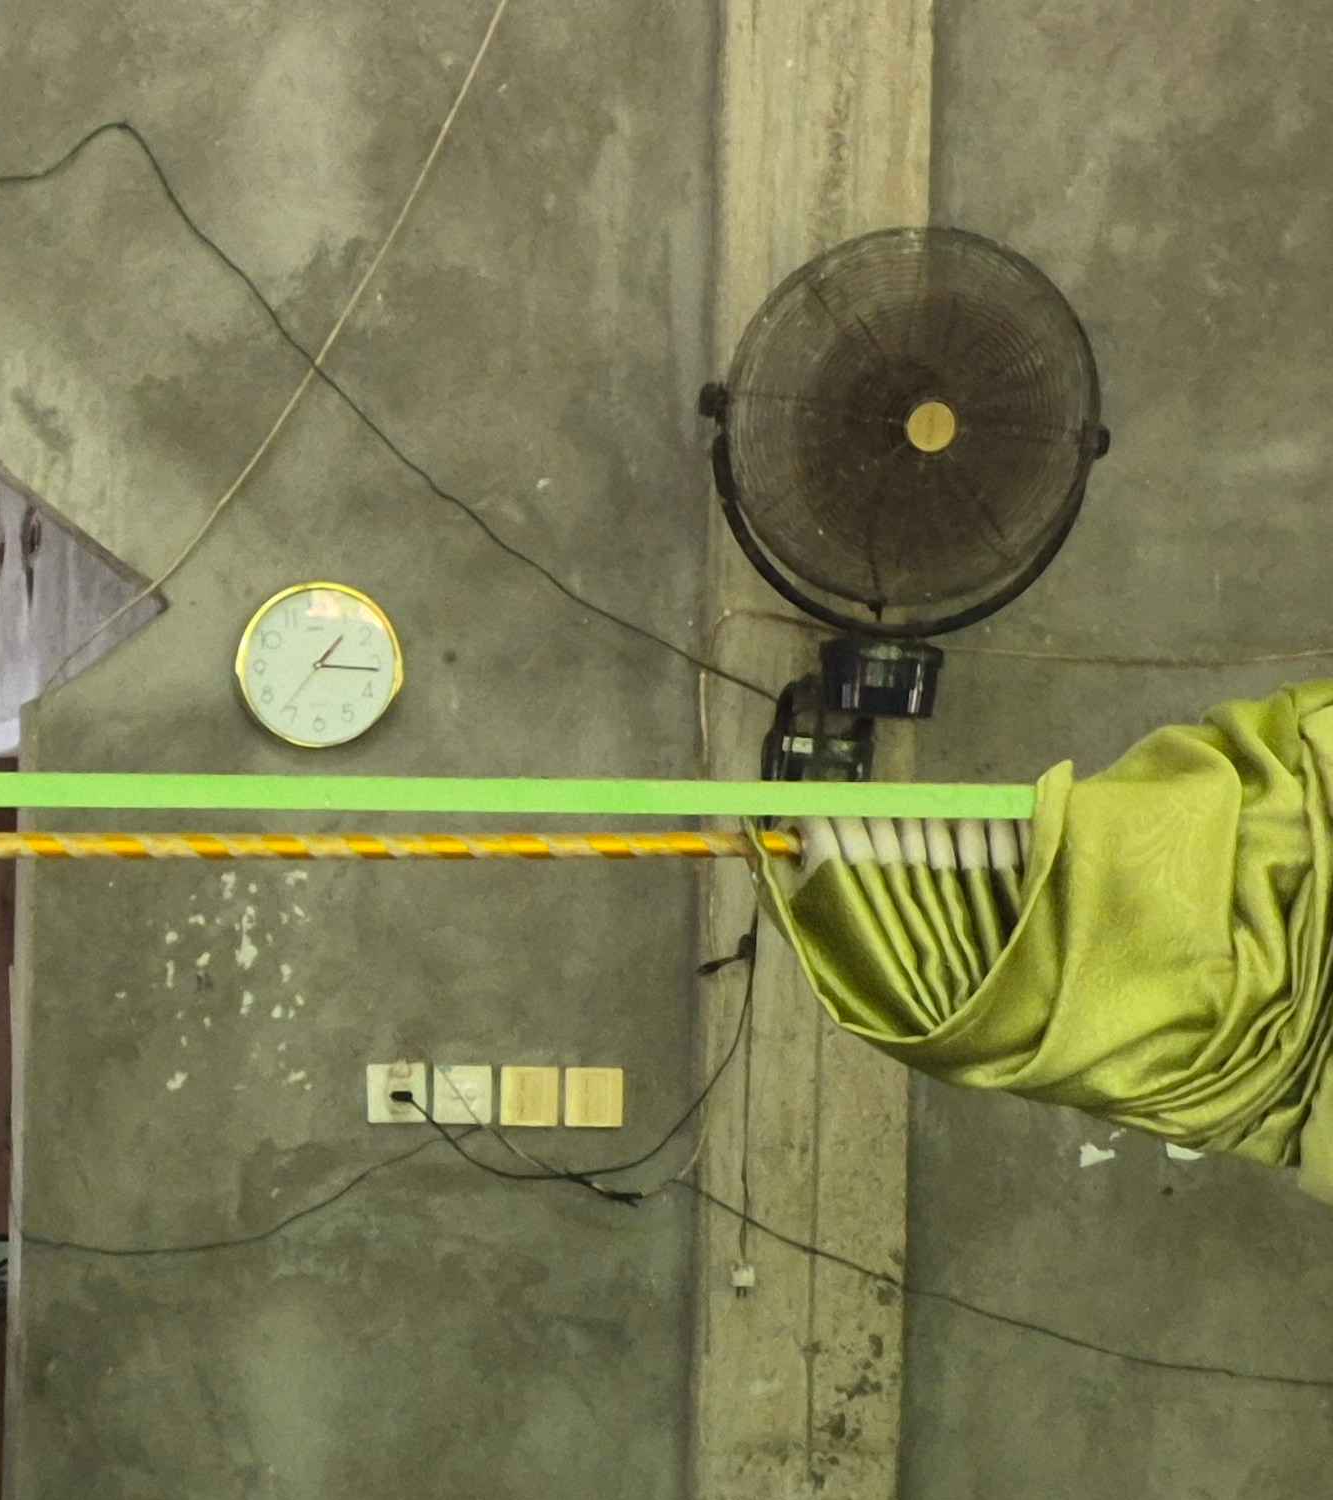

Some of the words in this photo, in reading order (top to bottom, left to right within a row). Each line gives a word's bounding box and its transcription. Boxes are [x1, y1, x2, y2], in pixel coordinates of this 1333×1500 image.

[358, 625, 373, 647] 2
[361, 680, 374, 699] 4
[280, 704, 299, 725] 7
[341, 703, 354, 723] 5
[312, 714, 326, 733] 6
